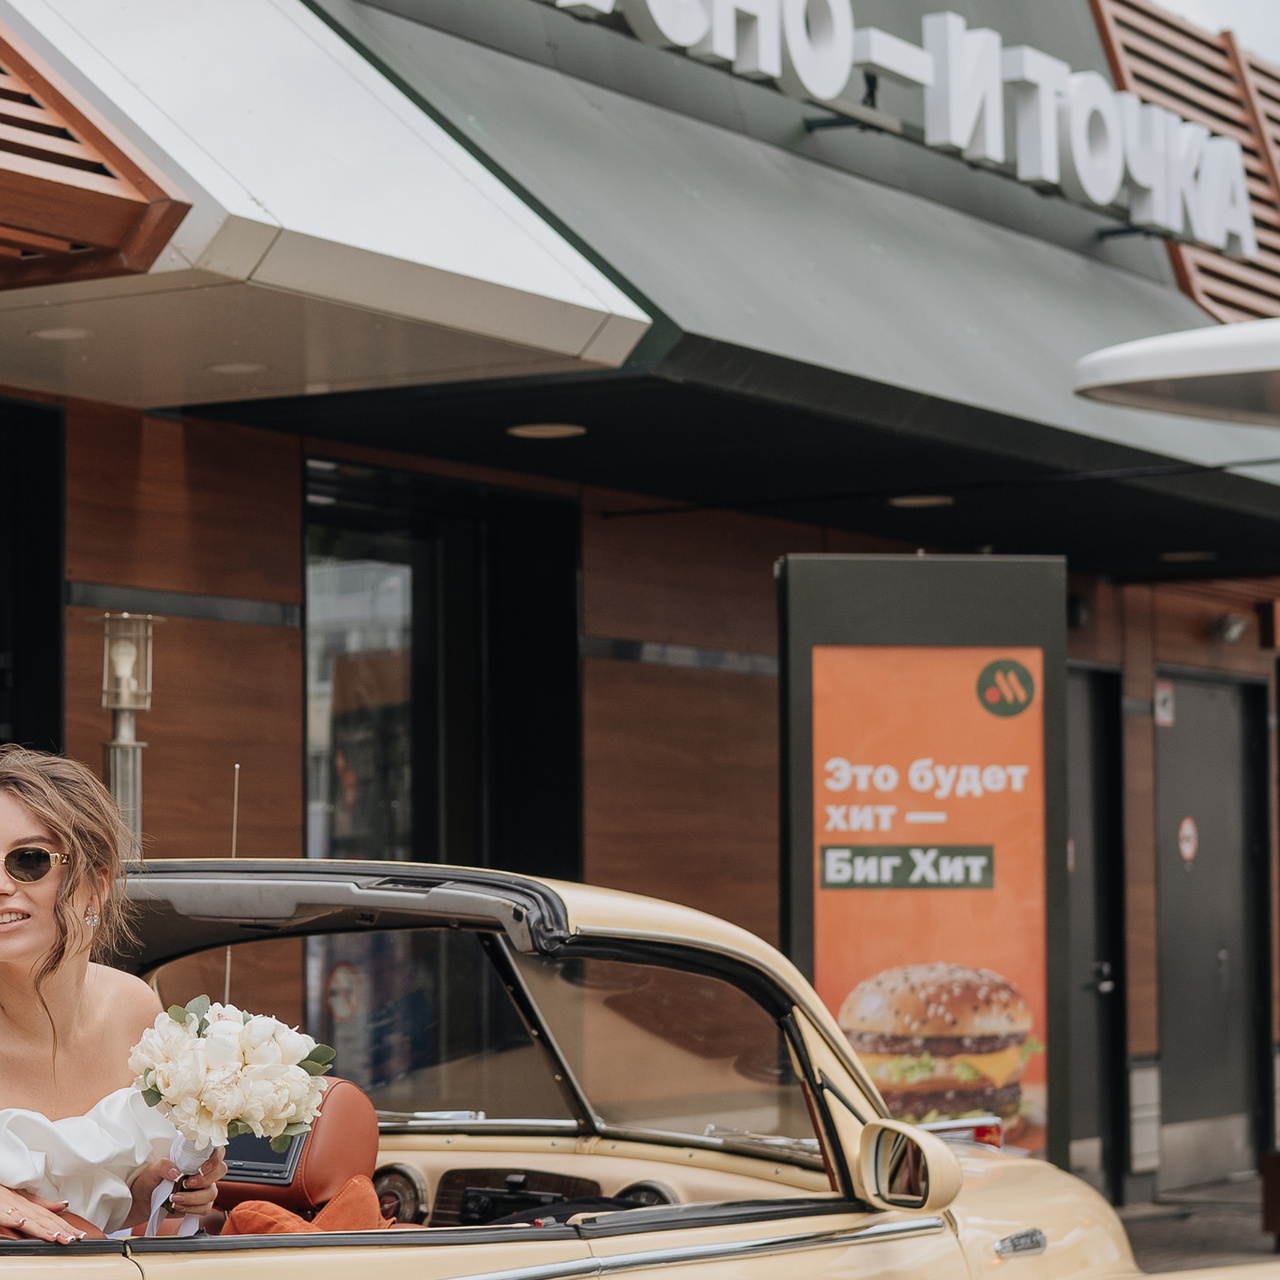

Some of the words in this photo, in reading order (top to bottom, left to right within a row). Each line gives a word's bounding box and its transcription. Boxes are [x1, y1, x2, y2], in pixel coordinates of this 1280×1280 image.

[923, 10, 1004, 165] И
[1002, 45, 1259, 260] ТОЧКА
[823, 756, 899, 793] Это
[907, 757, 1029, 800] будет
[824, 805, 897, 832] хит
[824, 848, 902, 884] Биг
[908, 848, 988, 884] Хит
